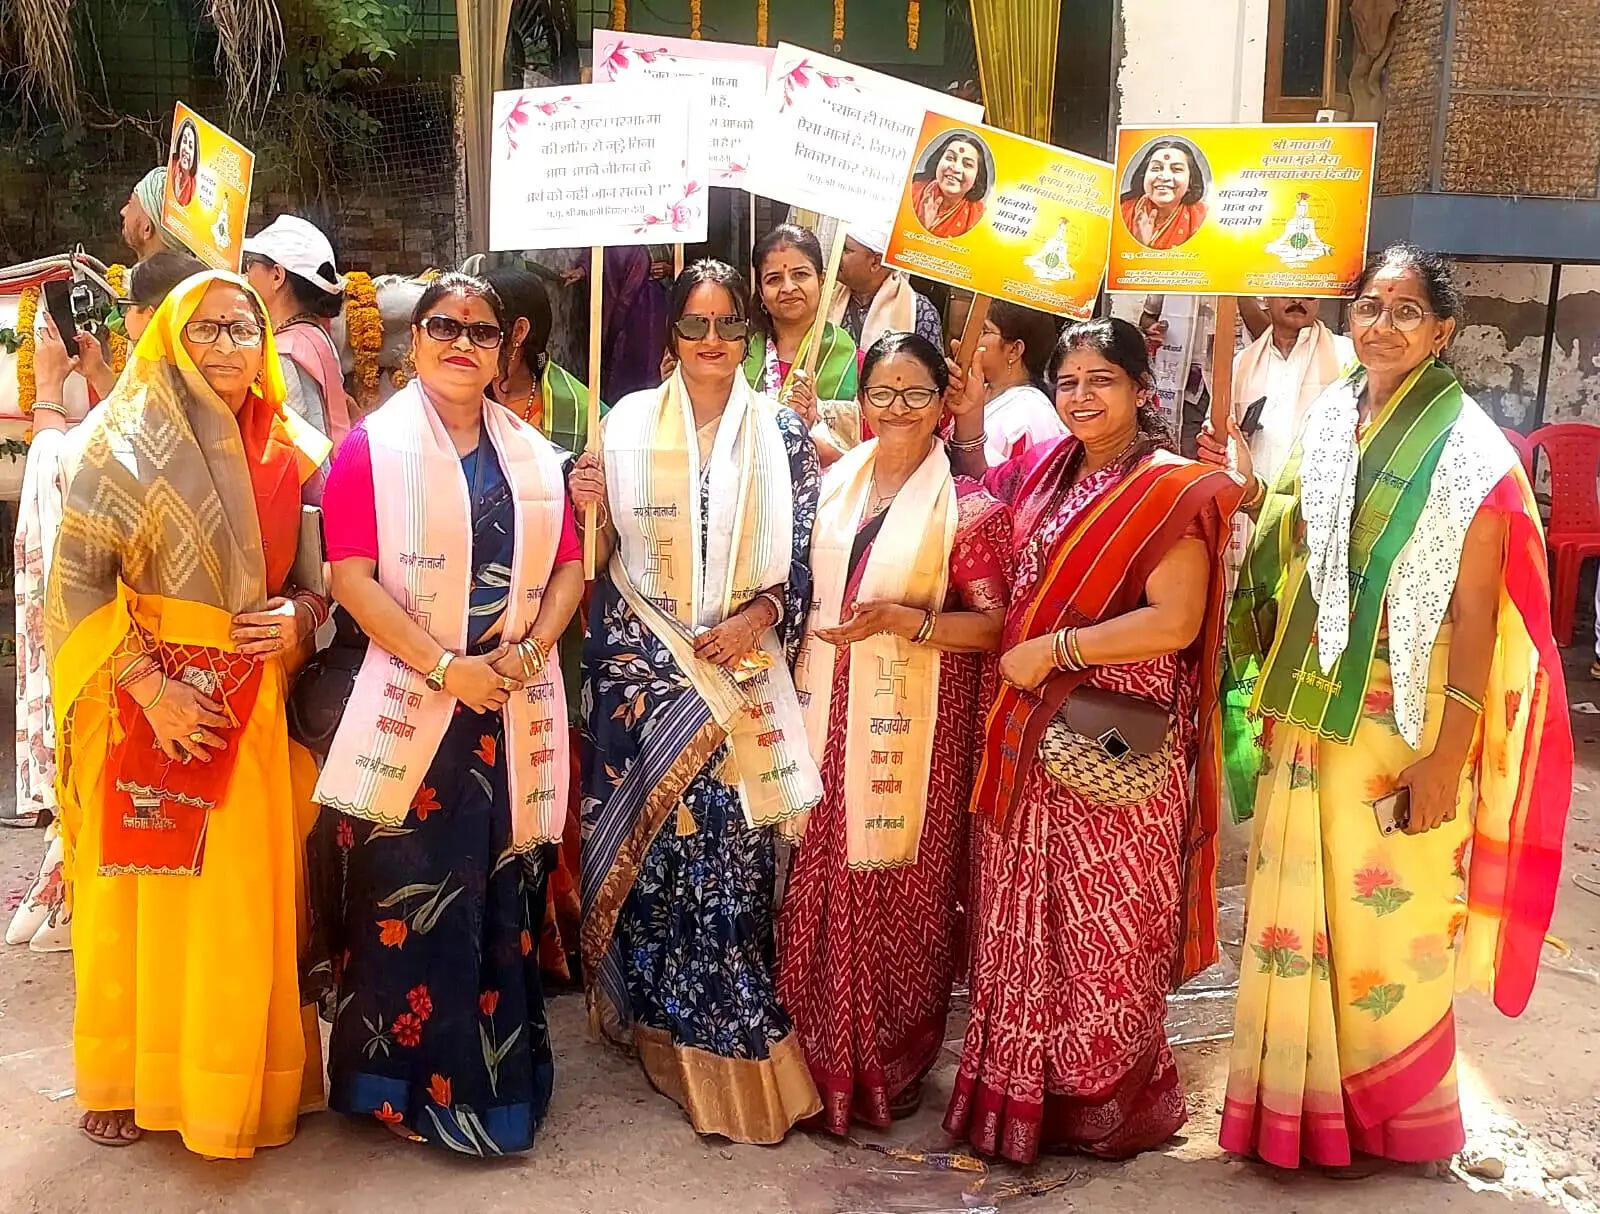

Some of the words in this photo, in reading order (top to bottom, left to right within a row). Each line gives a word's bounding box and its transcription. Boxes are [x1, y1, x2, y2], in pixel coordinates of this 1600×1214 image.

[1289, 138, 1331, 150] माताजी
[1218, 187, 1268, 199] सहजयोग
[1218, 215, 1262, 227] महायोग
[384, 683, 406, 704] आज
[407, 691, 424, 709] का
[375, 715, 417, 741] महायोग
[870, 711, 912, 735] सहजयोग
[355, 754, 371, 769] जय
[870, 749, 888, 765] आज
[891, 751, 903, 765] का
[871, 774, 902, 795] महायोग
